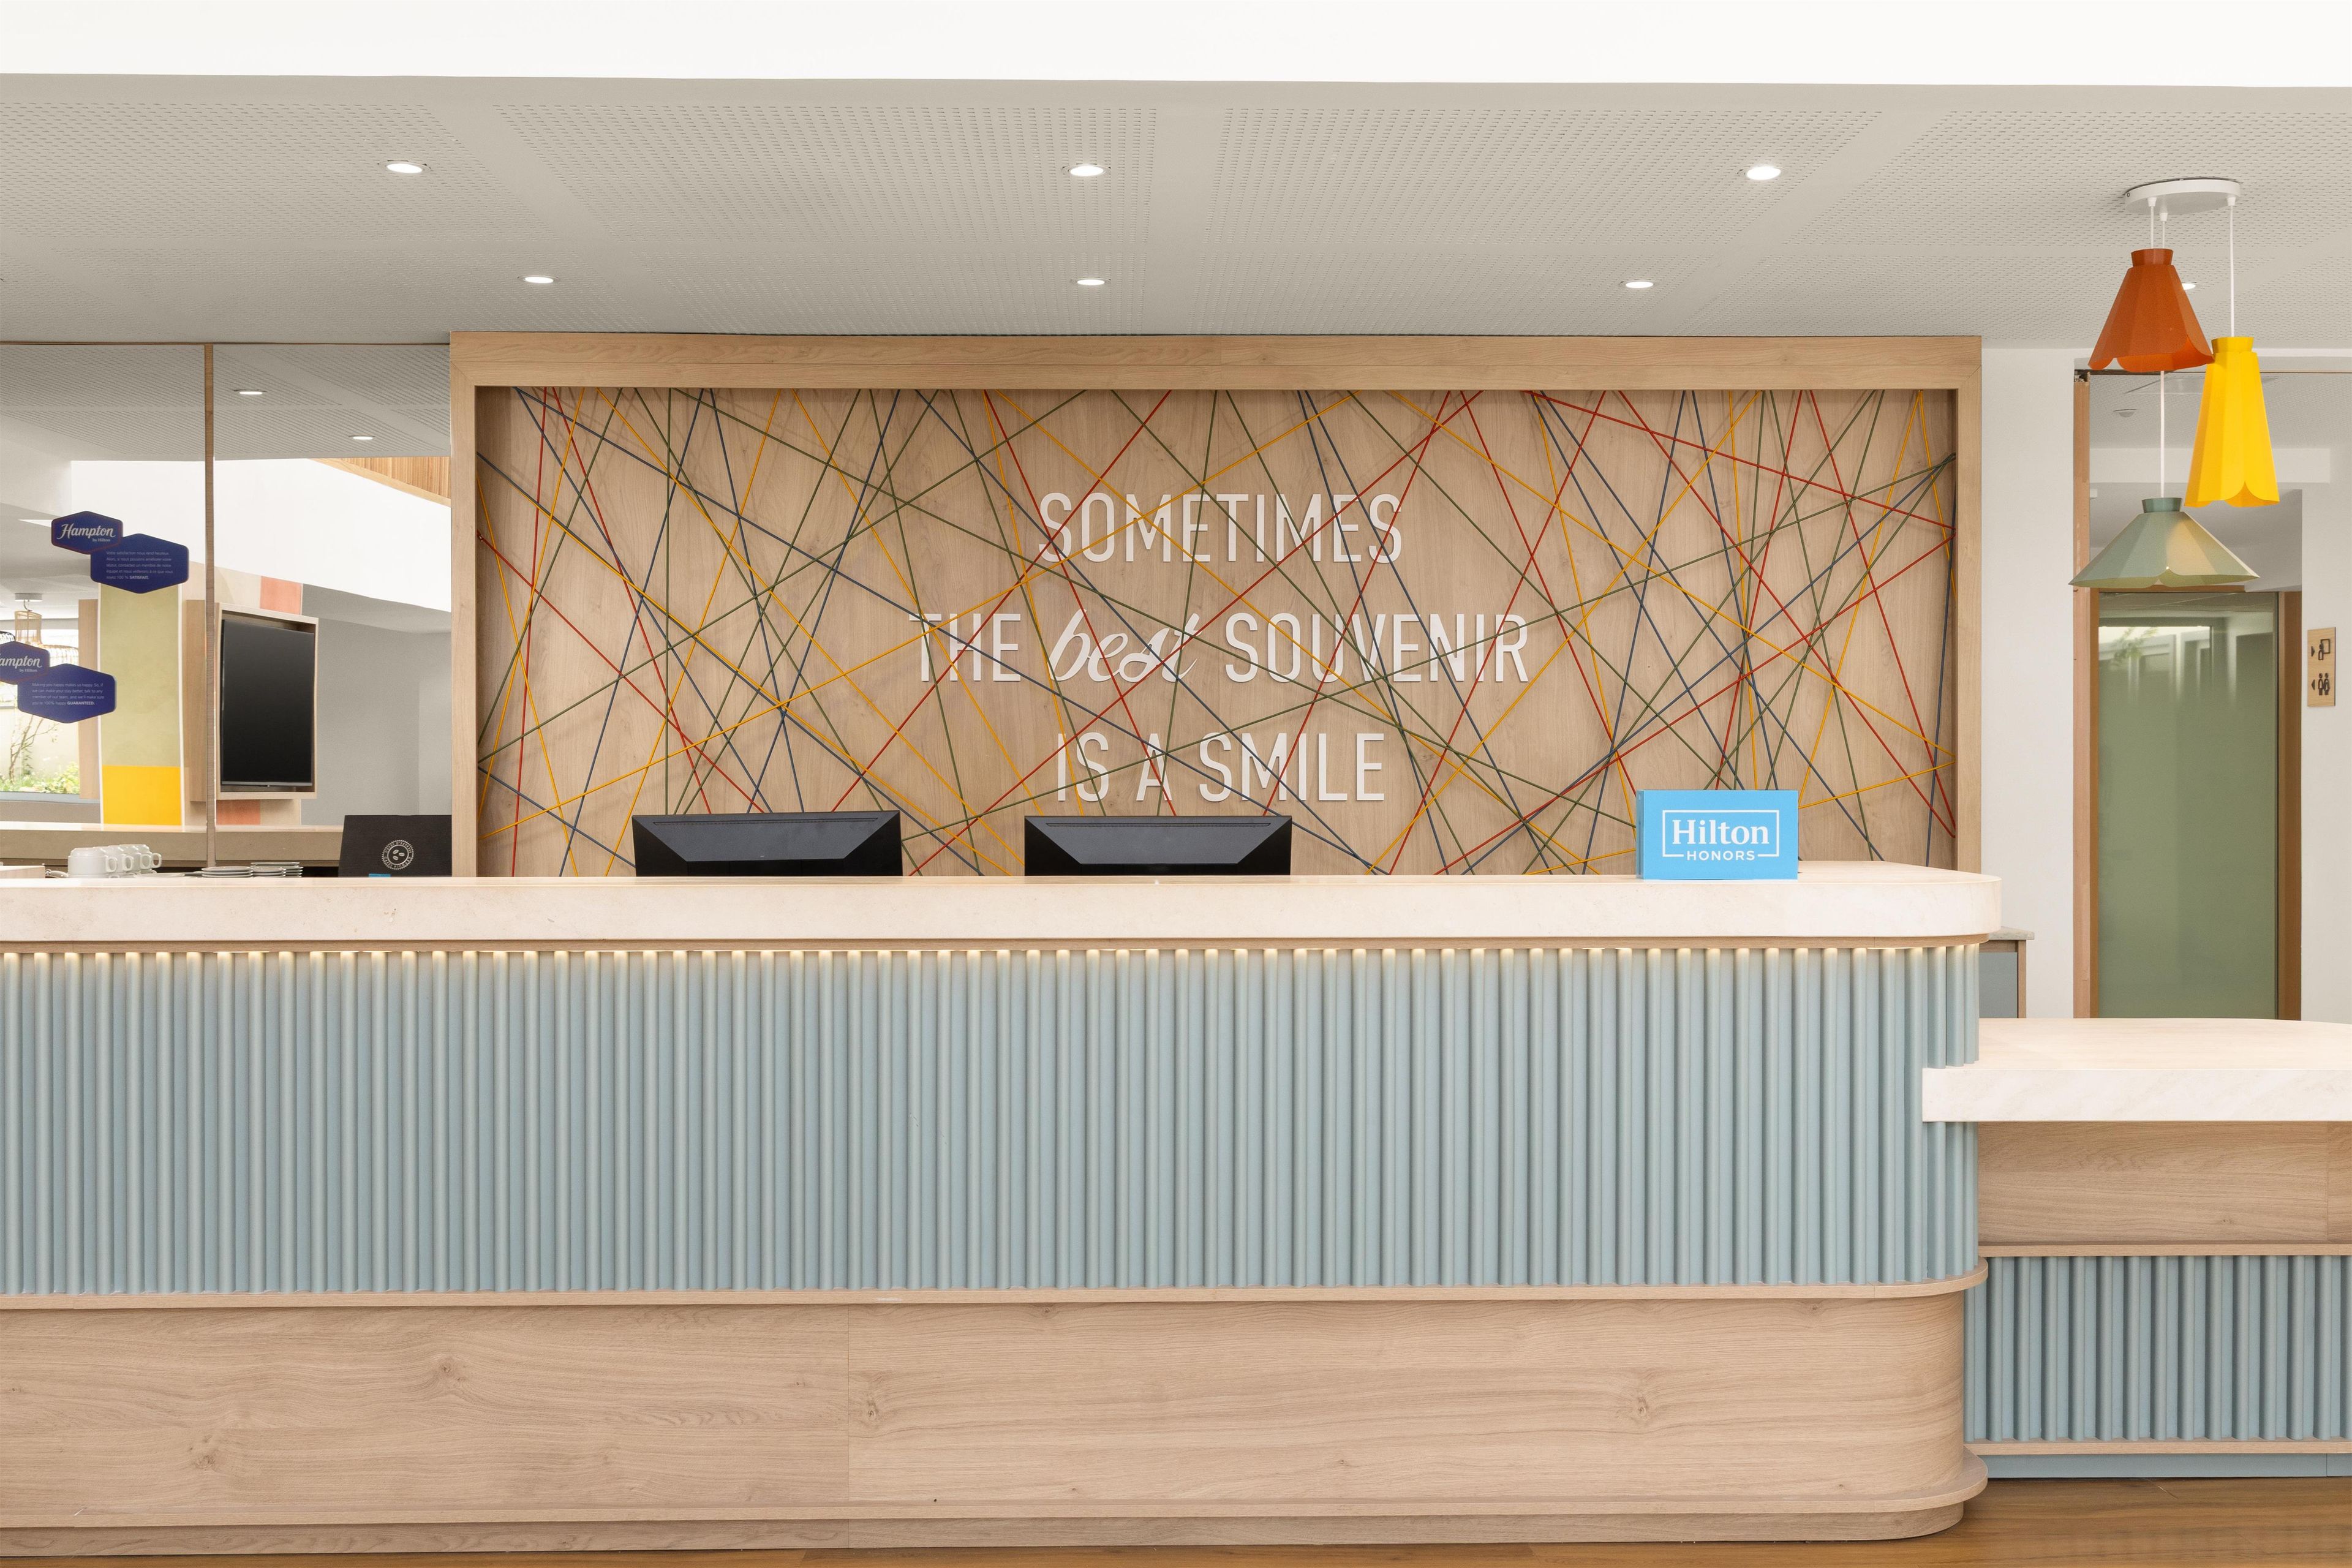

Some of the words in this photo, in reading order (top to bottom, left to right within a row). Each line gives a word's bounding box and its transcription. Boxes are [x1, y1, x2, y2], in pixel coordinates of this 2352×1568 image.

[56, 523, 116, 539] Hampton
[1038, 492, 1402, 563] SOMETIMES
[910, 612, 1021, 682] THE
[1047, 608, 1200, 684] best
[1225, 612, 1529, 683] SOUVENIR
[0, 654, 42, 669] ampton
[1058, 732, 1109, 802] IS
[1137, 733, 1172, 802] A
[1199, 732, 1385, 802] SMILE
[1672, 820, 1769, 845] Hilton
[1687, 850, 1755, 861] HONORS
